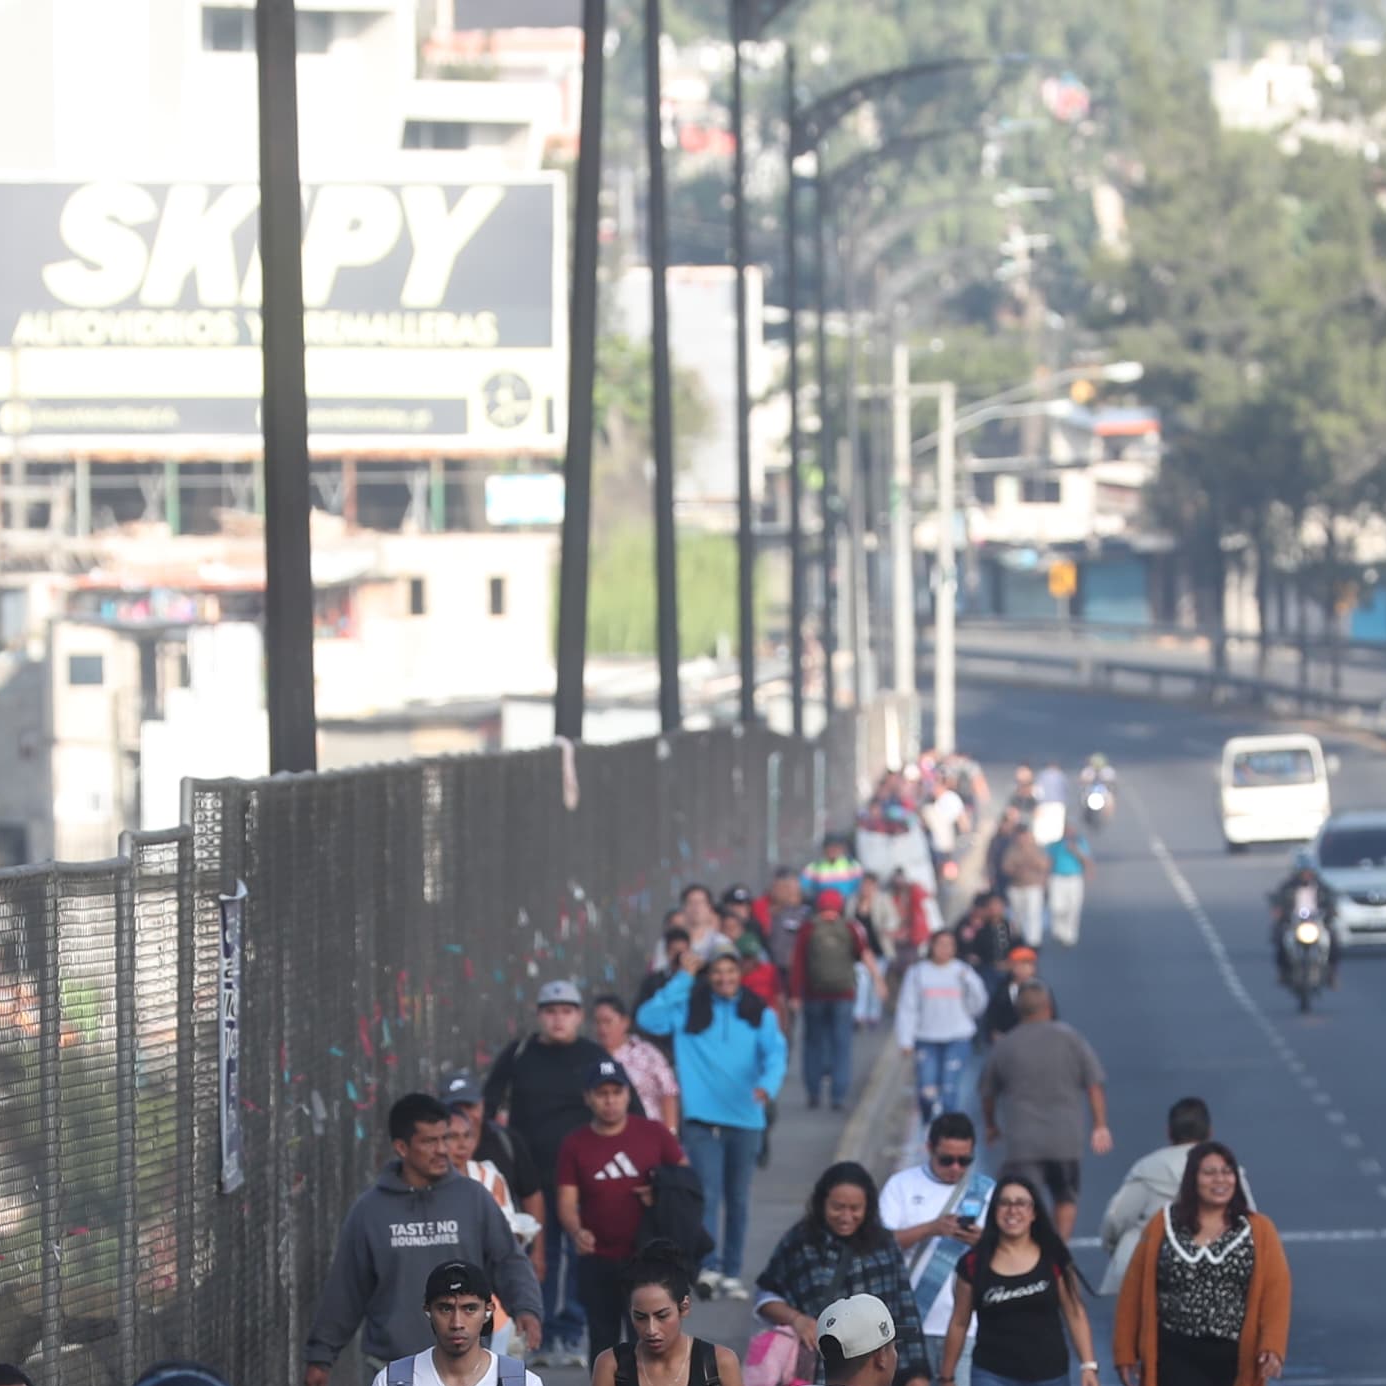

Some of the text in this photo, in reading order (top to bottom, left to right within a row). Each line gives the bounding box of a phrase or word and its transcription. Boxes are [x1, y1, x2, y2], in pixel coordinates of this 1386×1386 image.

[389, 1220, 459, 1236] TASTE NO
[391, 1233, 459, 1247] BOUNDARIES
